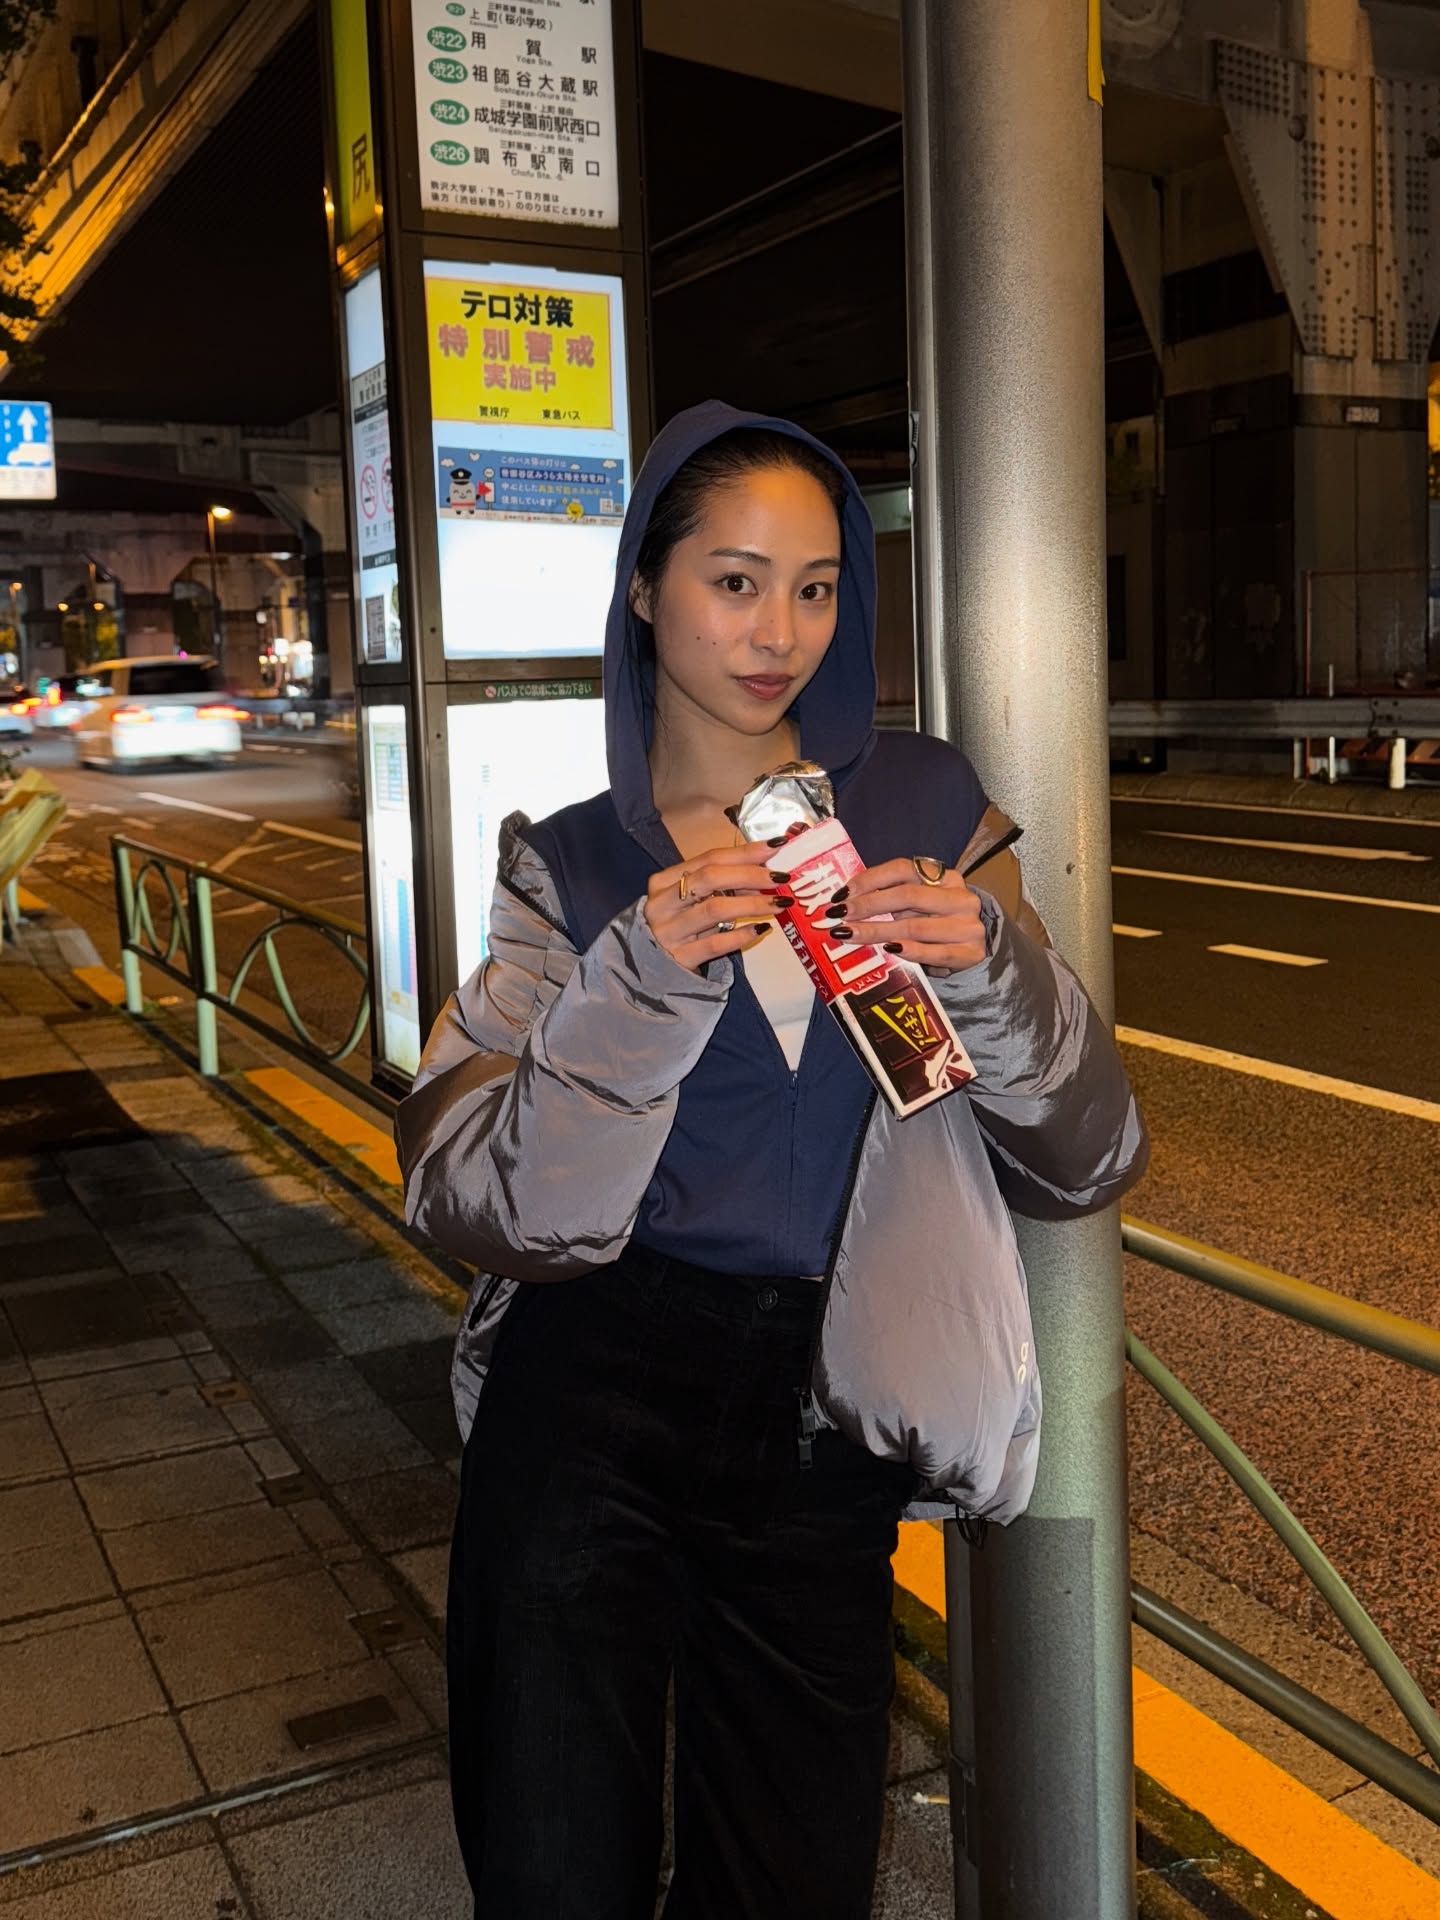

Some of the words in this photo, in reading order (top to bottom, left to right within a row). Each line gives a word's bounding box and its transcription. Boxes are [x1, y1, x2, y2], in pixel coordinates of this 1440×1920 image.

[431, 29, 464, 48] 渋22
[471, 31, 597, 64] 用賀駅
[432, 63, 465, 80] 渋23
[472, 64, 599, 97] 祖師谷大蔵駅
[434, 103, 466, 121] 渋24
[474, 107, 600, 137] 成城学園前駅西口
[434, 144, 466, 162] 渋26
[474, 146, 600, 177] 調布駅南口
[511, 168, 535, 178] Chofu
[461, 290, 573, 328] テロ対策
[438, 324, 595, 368] 特別警戒
[483, 364, 556, 393] 実施中
[479, 405, 510, 419] 警視庁
[542, 408, 581, 420] 東急バス
